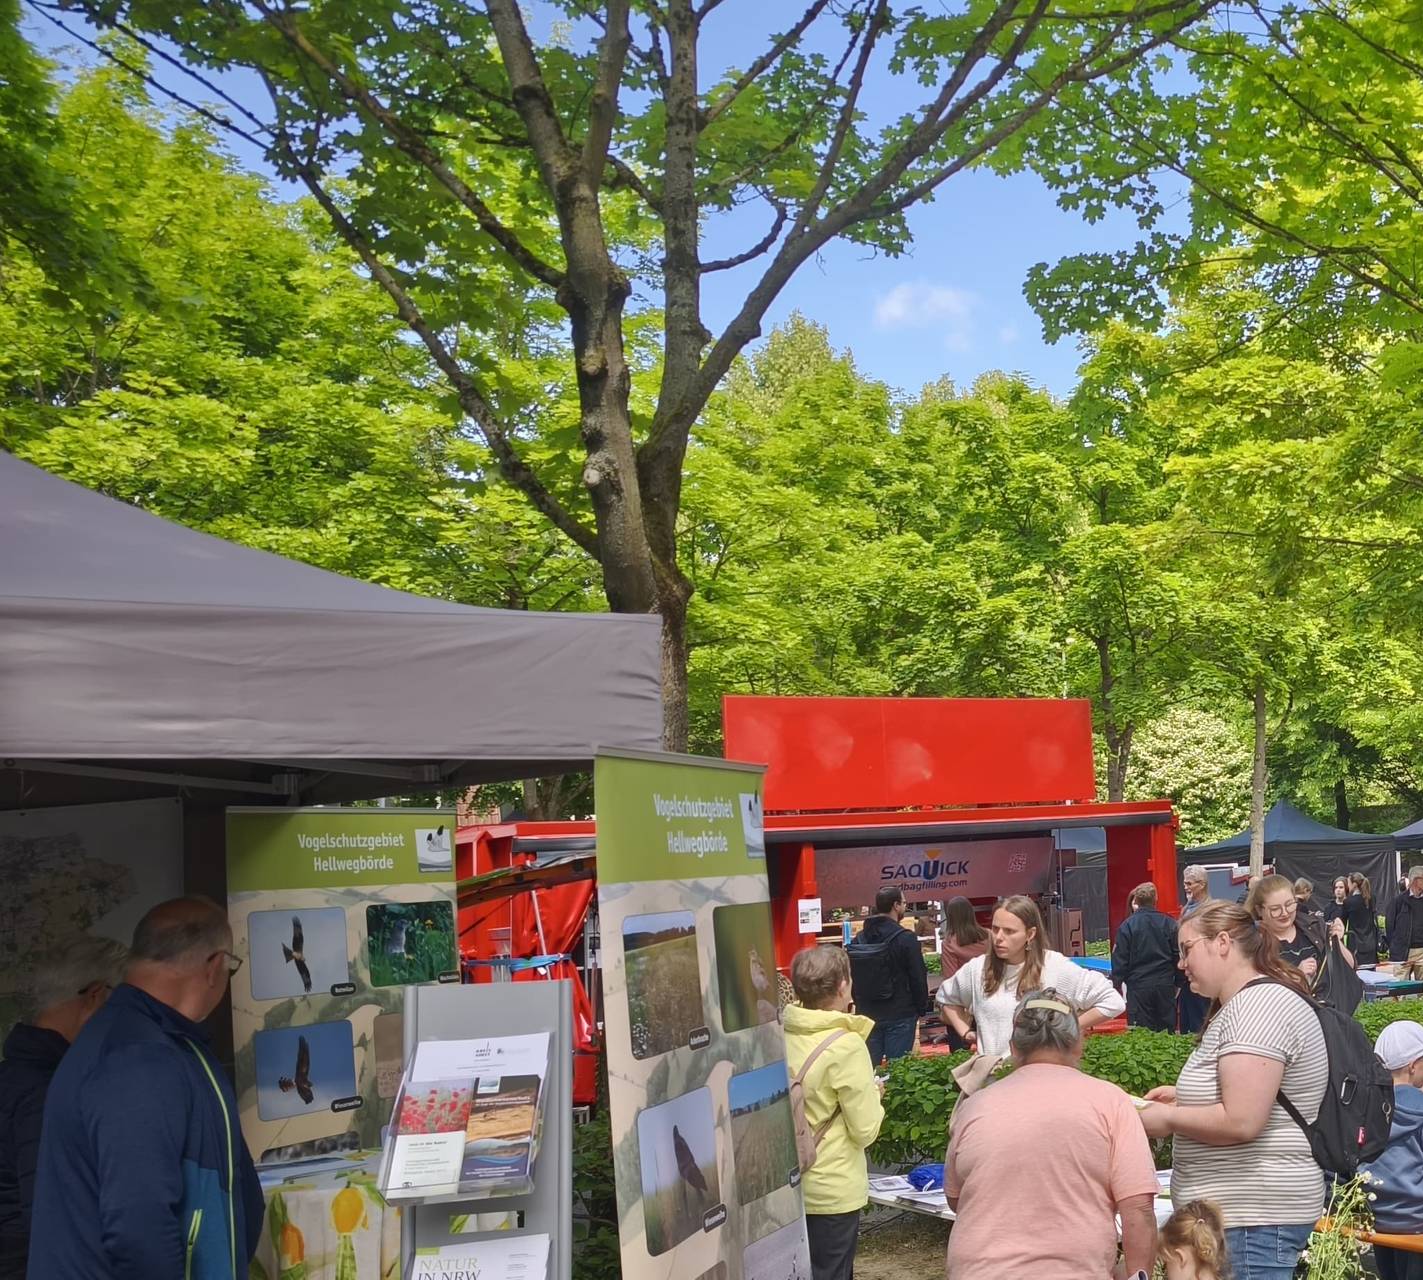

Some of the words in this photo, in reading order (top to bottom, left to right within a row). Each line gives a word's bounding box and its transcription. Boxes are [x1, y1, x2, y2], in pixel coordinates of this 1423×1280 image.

[653, 793, 734, 823] Vogelschutzgebiet
[297, 832, 405, 851] Vogelschutzgebiet
[667, 830, 728, 858] Hellwegbörde
[313, 855, 394, 874] Hellwegbörde
[881, 860, 969, 880] SAQUICK
[880, 879, 968, 893] dbagfilling.com
[420, 1257, 479, 1271] NATUR
[441, 1270, 481, 1280] NRW
